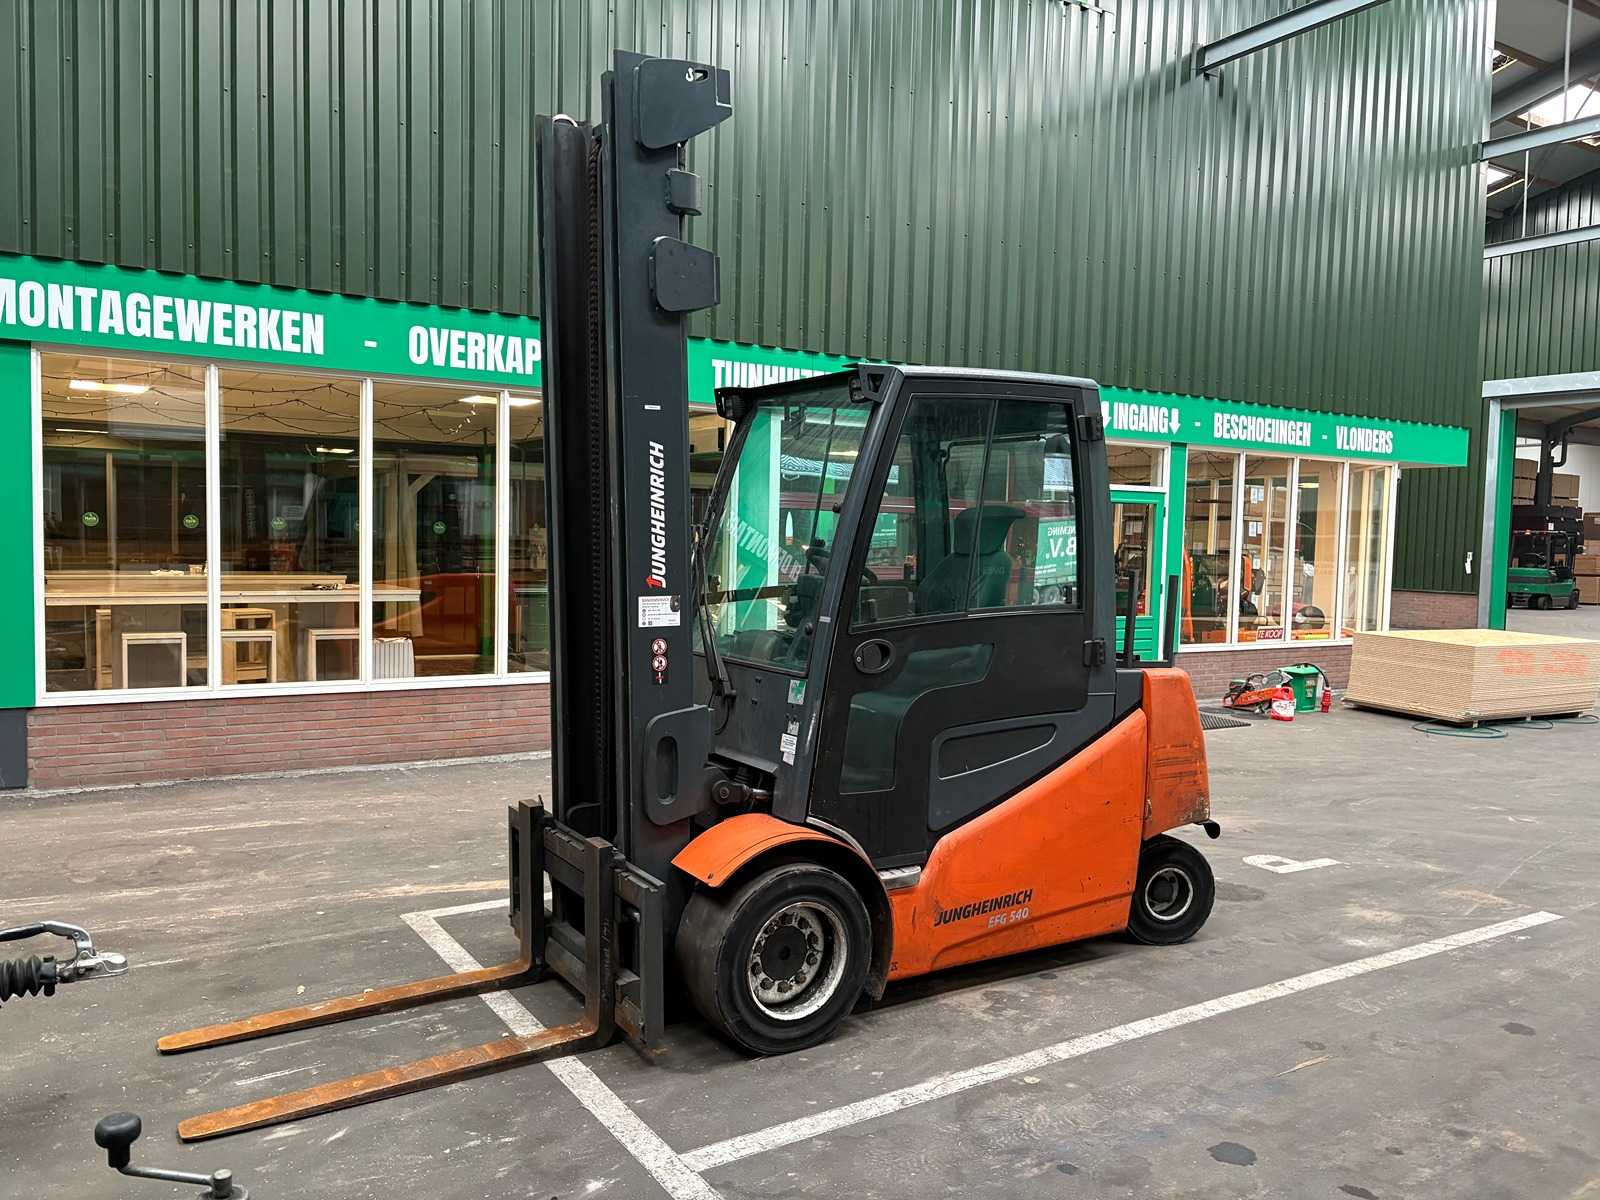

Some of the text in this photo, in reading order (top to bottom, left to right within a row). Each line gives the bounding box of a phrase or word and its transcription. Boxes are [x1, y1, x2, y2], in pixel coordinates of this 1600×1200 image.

[408, 324, 541, 375] OVERKAP
[1113, 402, 1168, 434] INGANG
[1213, 412, 1311, 447] BESCHOEIINGEN
[1336, 425, 1394, 454] VLONDERS
[647, 441, 667, 589] JUNGHEINRICH
[934, 888, 1033, 927] JUNGHEINRICH
[987, 913, 1007, 928] EFG
